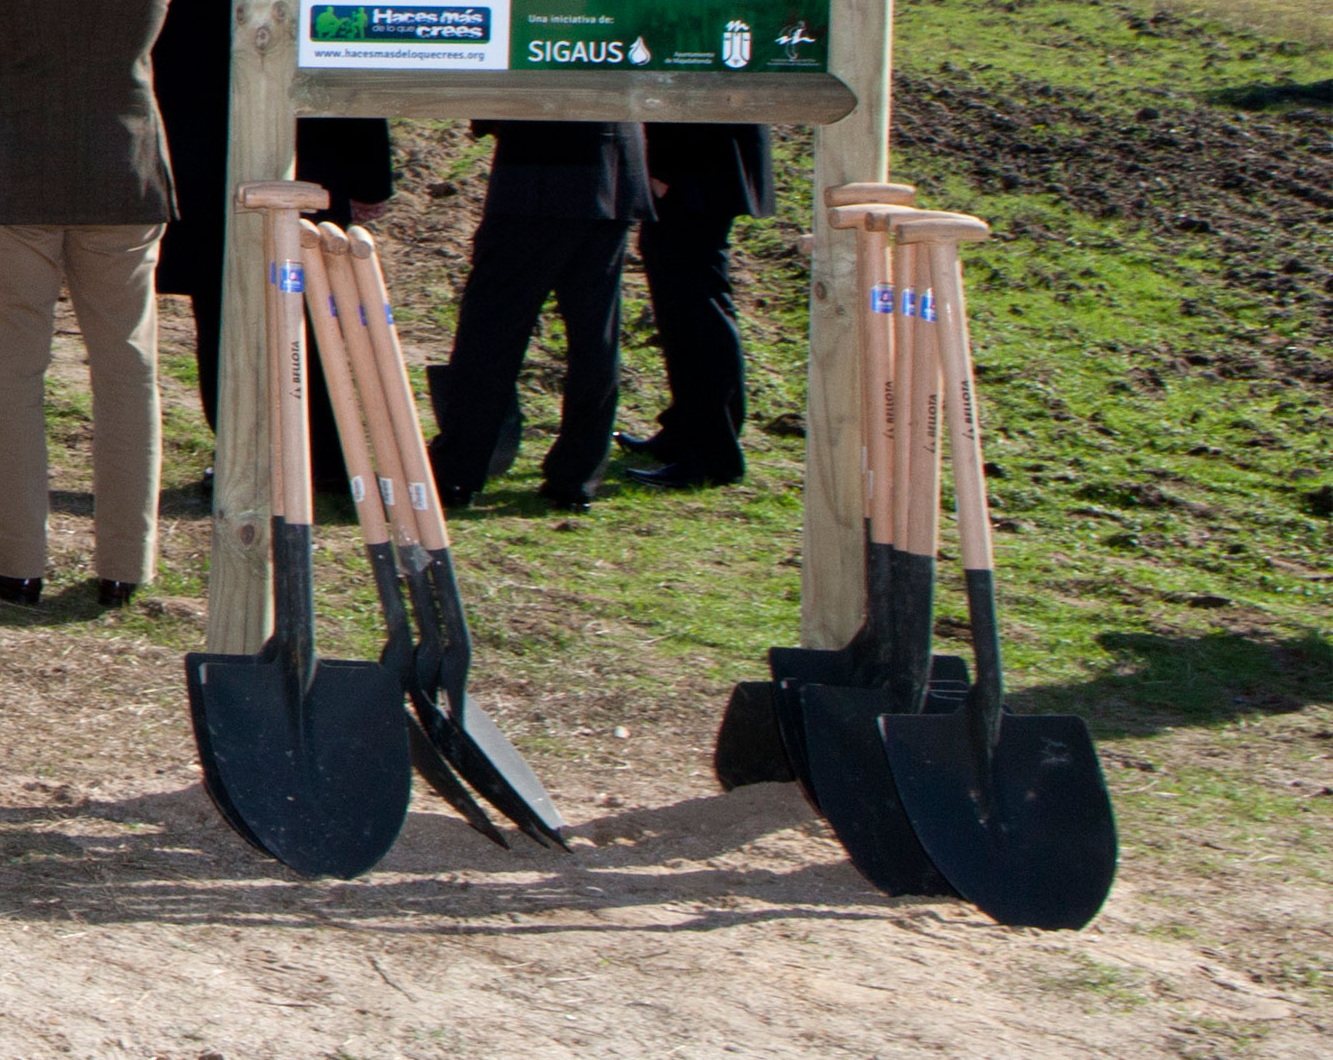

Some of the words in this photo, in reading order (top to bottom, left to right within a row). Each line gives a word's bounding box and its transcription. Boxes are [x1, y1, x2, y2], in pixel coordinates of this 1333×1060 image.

[372, 8, 438, 24] Haces
[440, 8, 484, 24] más
[416, 25, 484, 38] crees
[314, 49, 485, 61] www.hacesmasdeloquecrees.org
[527, 40, 623, 63] SIGAUS
[290, 341, 301, 383] BELLOTA
